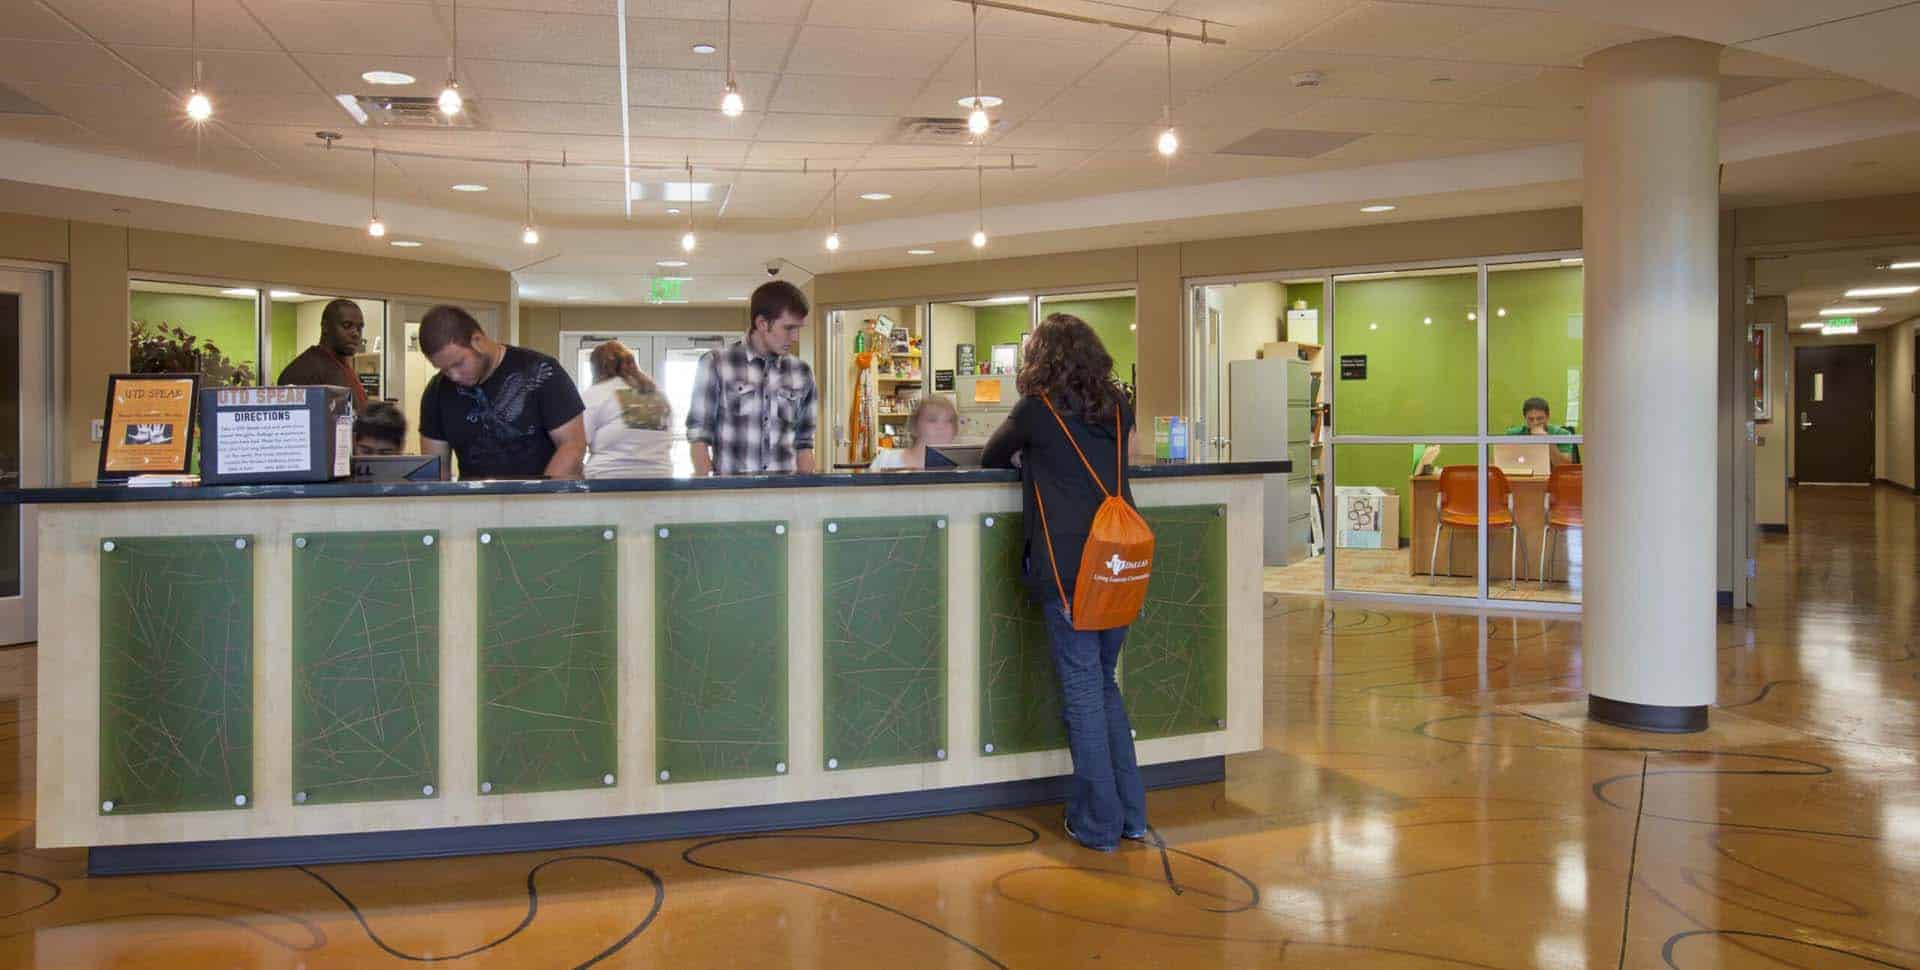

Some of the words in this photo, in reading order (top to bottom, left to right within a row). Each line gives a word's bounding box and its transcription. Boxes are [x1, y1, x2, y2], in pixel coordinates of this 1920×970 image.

[217, 387, 249, 404] UTD
[256, 387, 305, 403] SPEAK
[234, 410, 290, 422] DIRECTIONS
